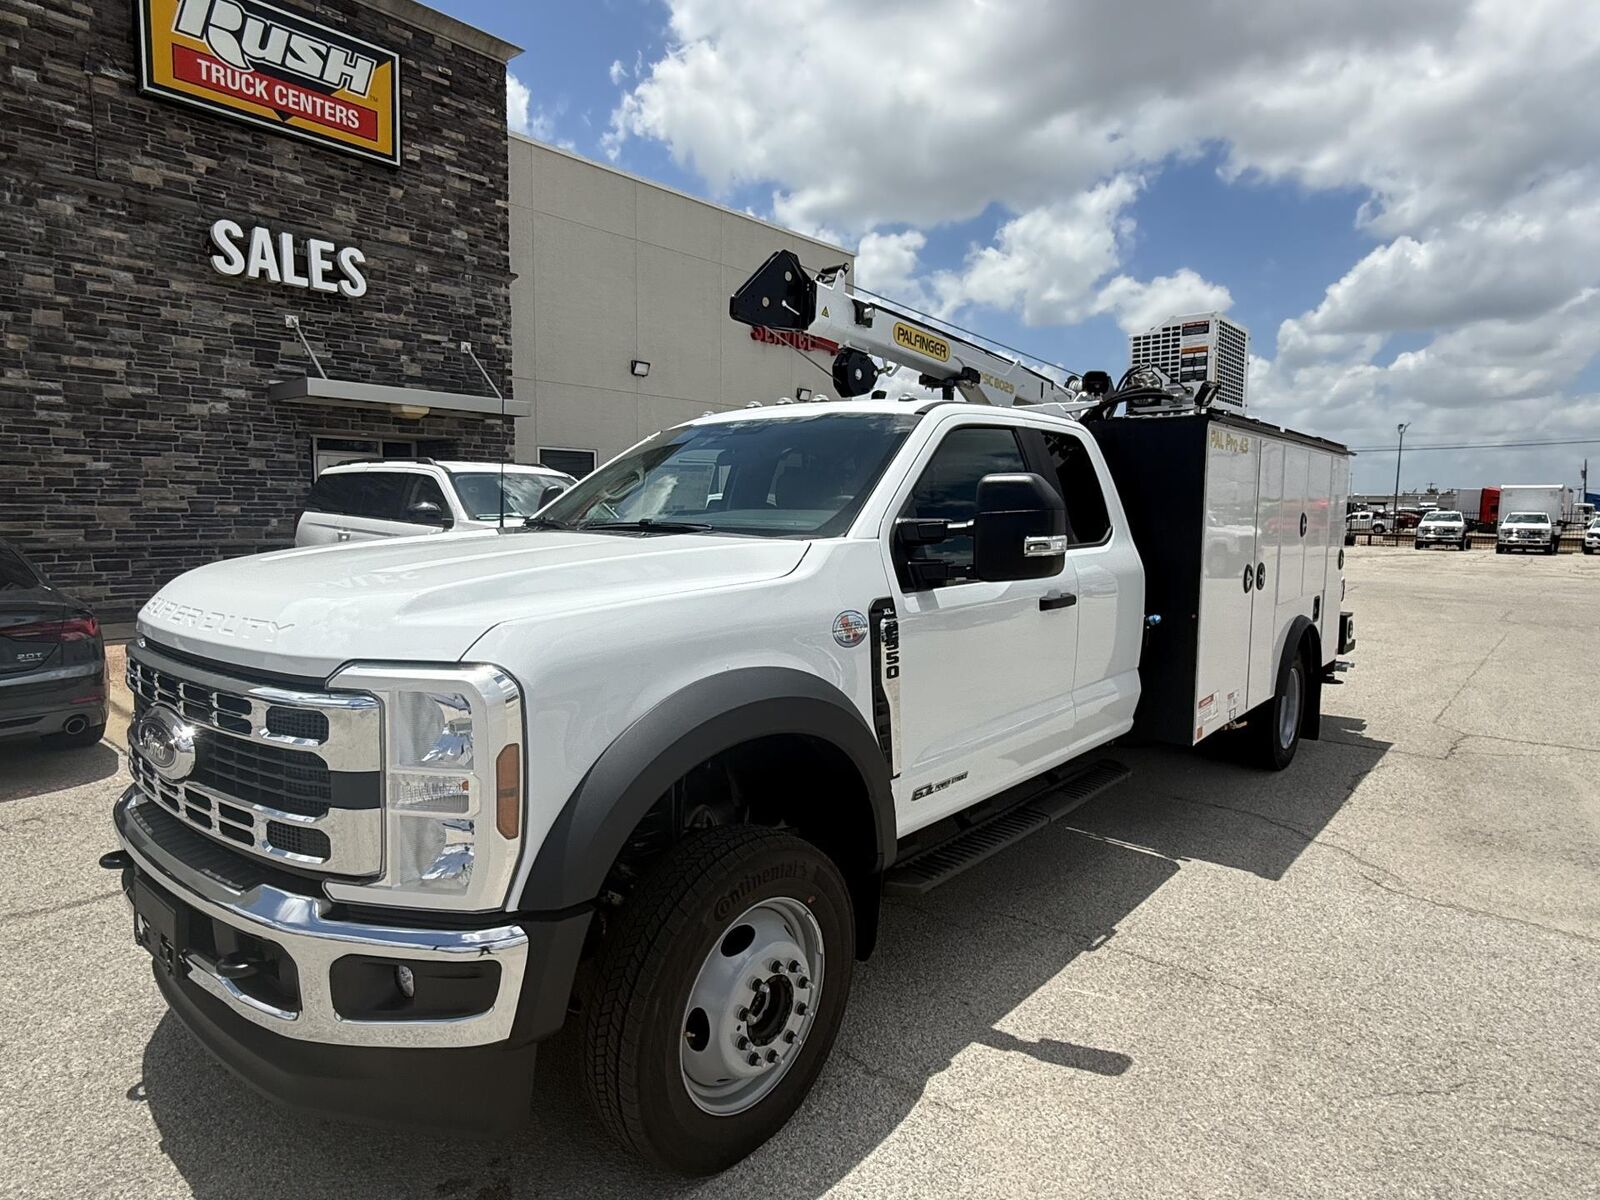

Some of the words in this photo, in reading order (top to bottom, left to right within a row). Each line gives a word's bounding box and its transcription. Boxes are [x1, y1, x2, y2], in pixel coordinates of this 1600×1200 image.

[197, 58, 269, 101] TRUCK
[274, 84, 360, 129] CENTERS
[210, 219, 368, 298] SALES
[896, 326, 947, 359] PALFINGER
[882, 608, 895, 616] XL
[713, 859, 799, 922] Continental
